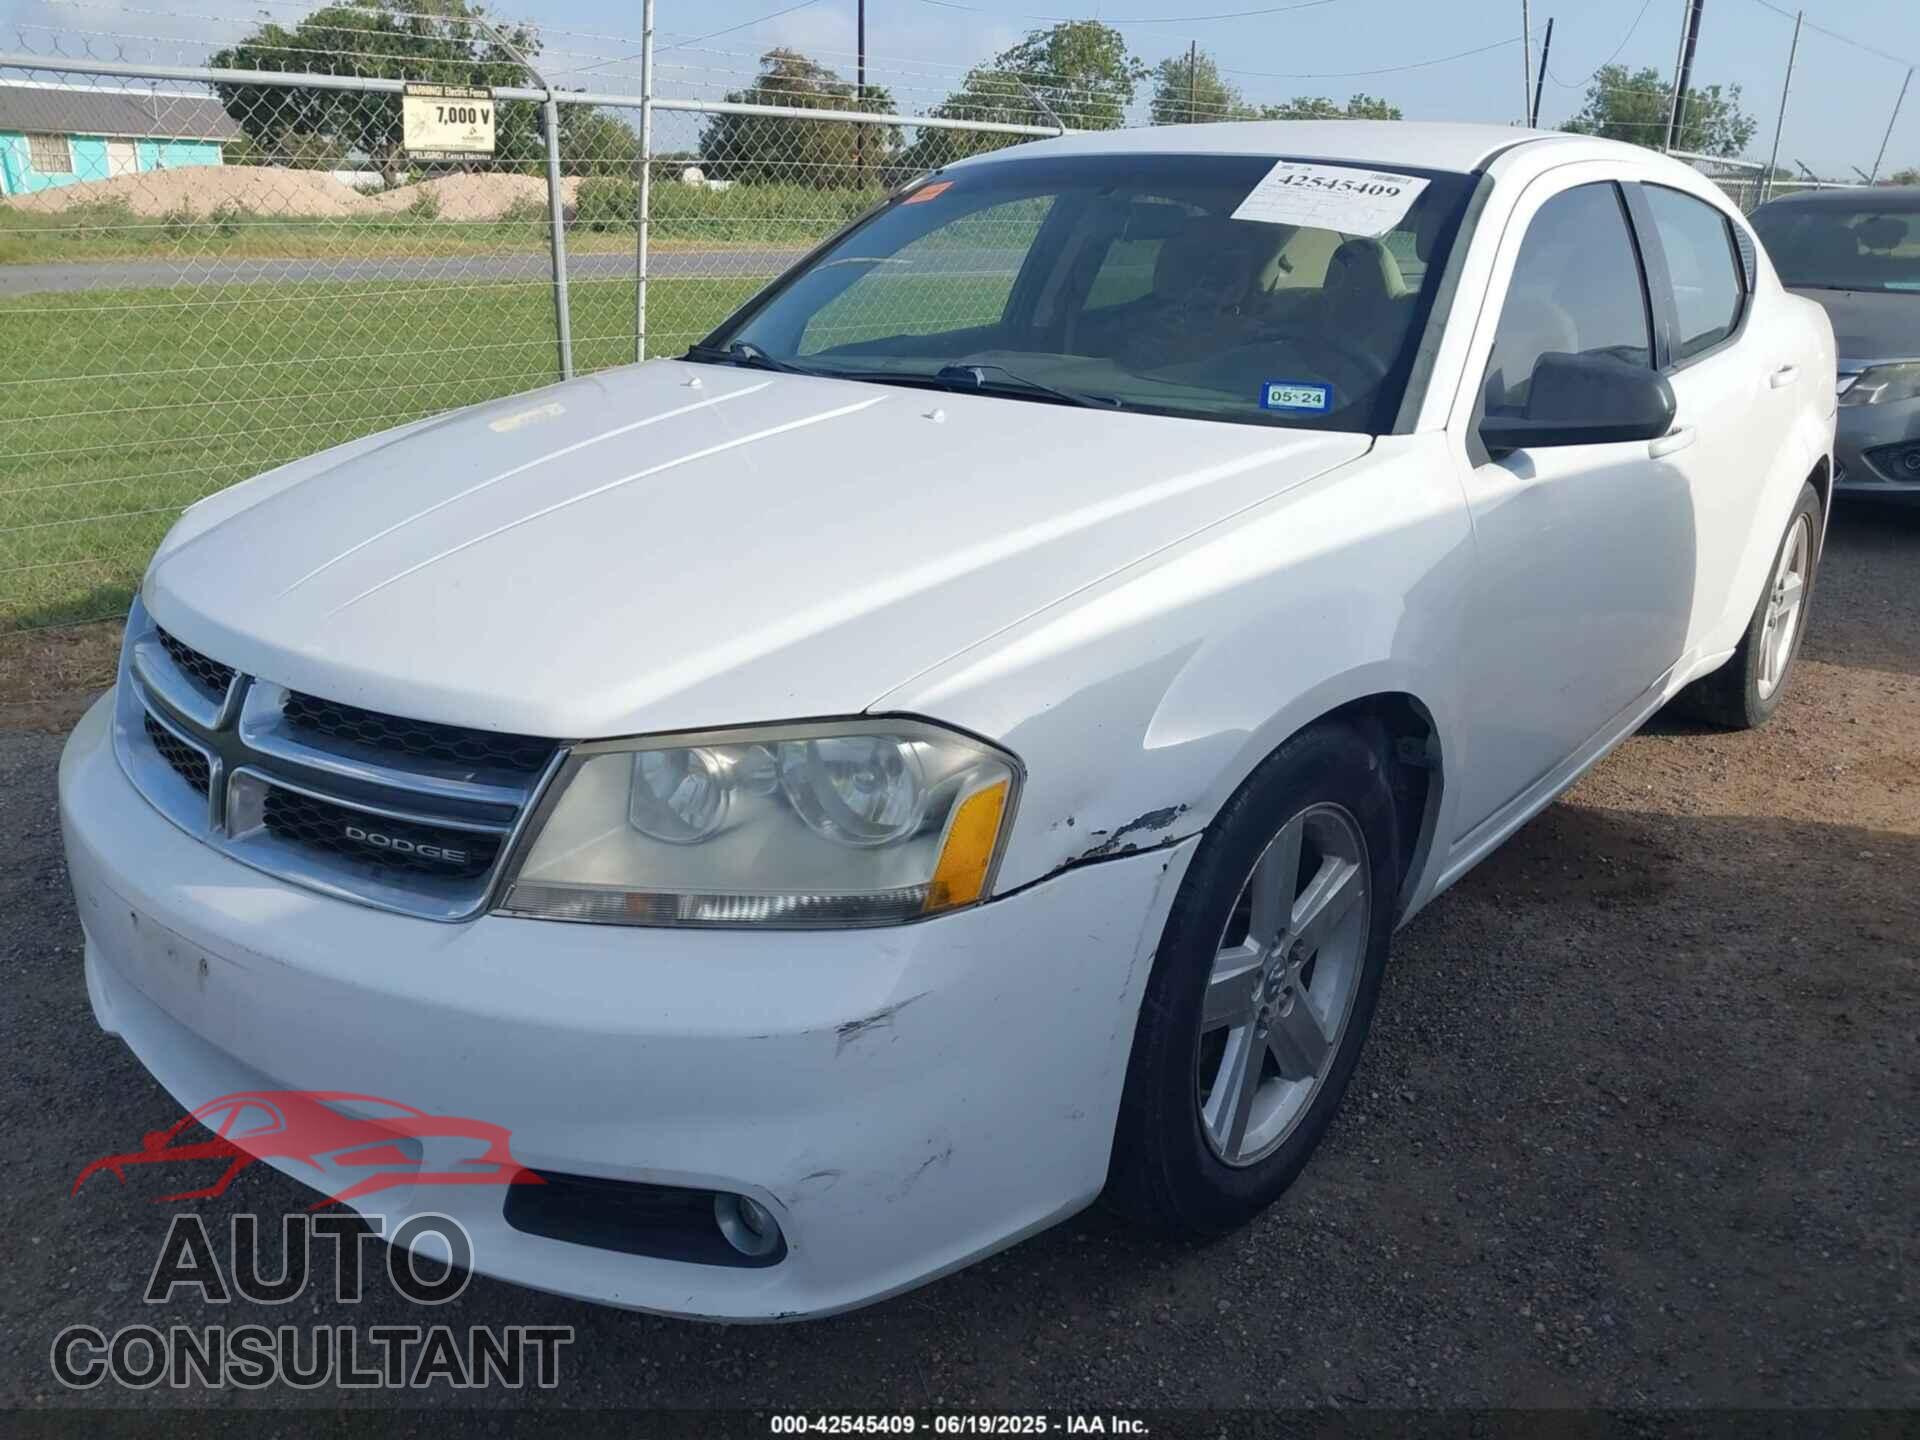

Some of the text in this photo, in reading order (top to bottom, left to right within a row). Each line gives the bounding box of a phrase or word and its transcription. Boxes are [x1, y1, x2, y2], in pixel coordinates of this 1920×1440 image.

[469, 87, 488, 98] Fence
[436, 106, 490, 126] 7,000 V
[1278, 174, 1401, 198] 42545409
[345, 826, 466, 863] DODGE
